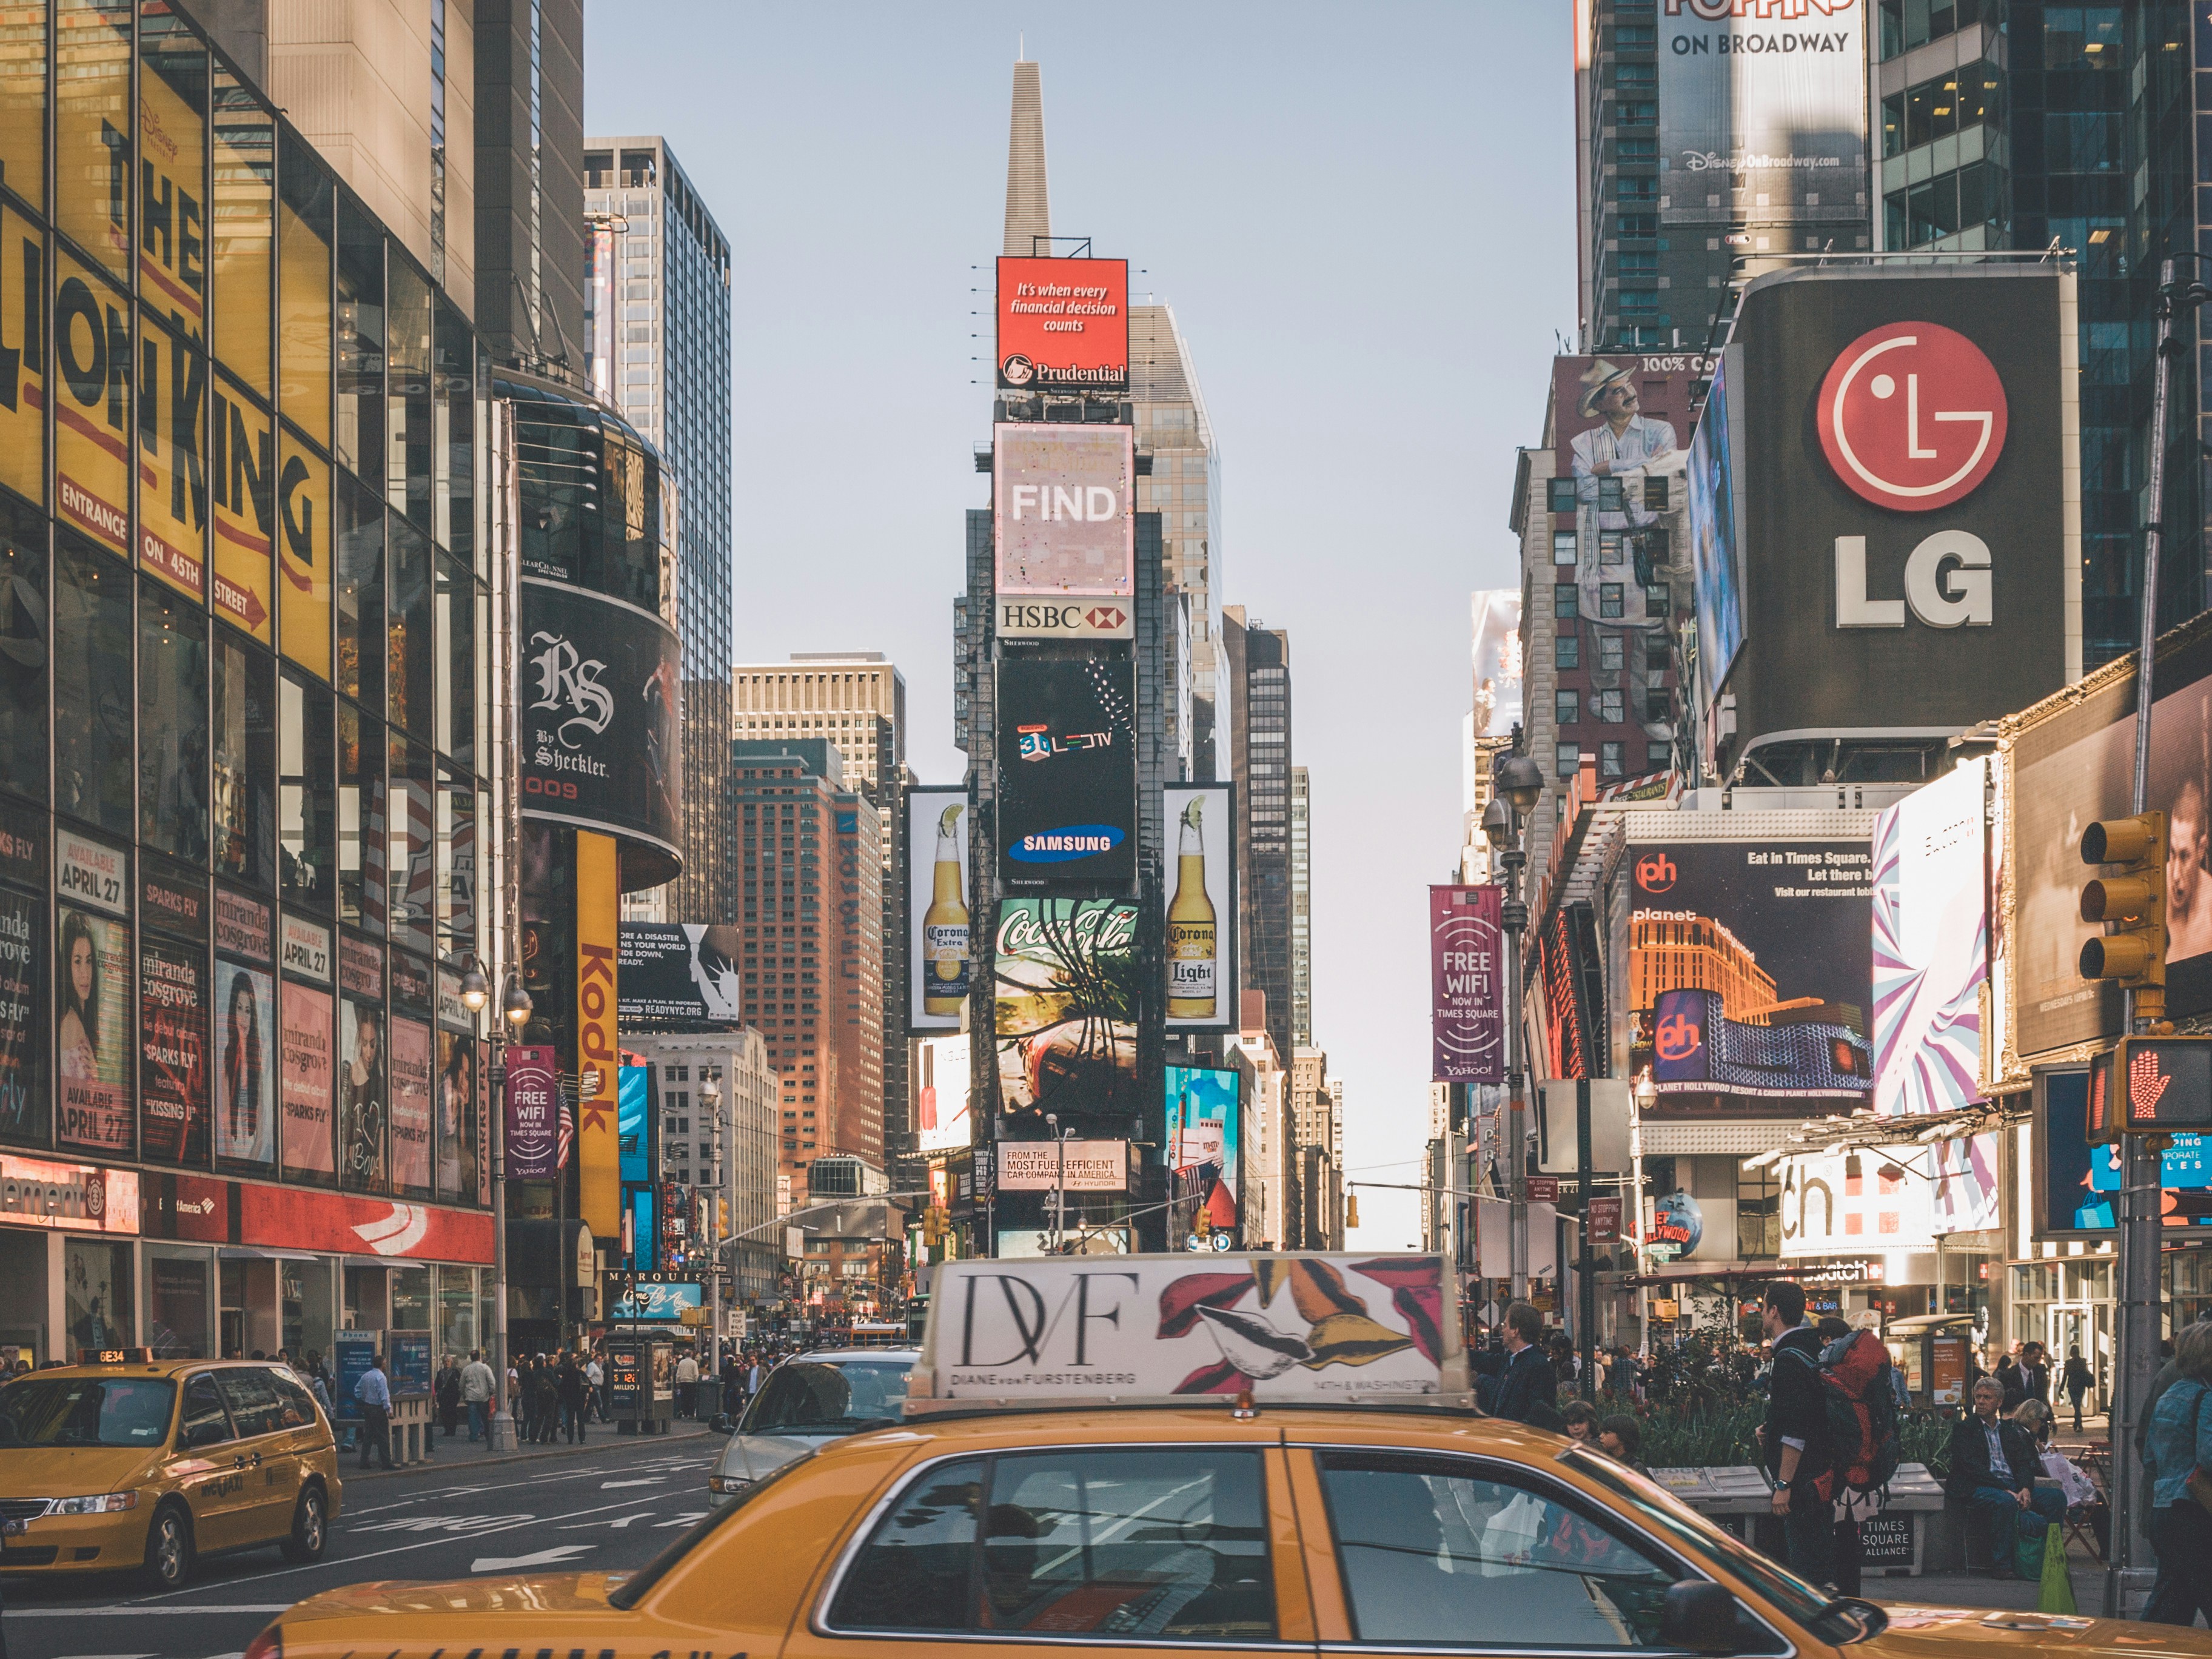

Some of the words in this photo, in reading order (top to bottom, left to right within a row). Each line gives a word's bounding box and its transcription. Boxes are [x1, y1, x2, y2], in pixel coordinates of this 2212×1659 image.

[1671, 34, 1709, 55] ON
[1718, 32, 1849, 55] BROADWAY
[102, 117, 202, 296] THE
[1017, 282, 1036, 296] It's
[1038, 283, 1071, 297] when
[1073, 287, 1107, 300] every
[1011, 300, 1065, 314] financial
[1067, 301, 1116, 315] decision
[1044, 320, 1084, 332] counts
[1036, 363, 1125, 381] Prudential
[1643, 357, 1686, 373] 100%
[172, 309, 313, 568] KING
[1012, 485, 1116, 521] FIND
[62, 481, 127, 541] ENTRANCE
[144, 535, 164, 564] ON
[170, 552, 199, 586] 45TH
[214, 578, 247, 617] STREET
[1835, 529, 1992, 629] LG
[1002, 606, 1081, 629] HSBC
[535, 729, 554, 746] By
[535, 745, 608, 778] Sheckler
[1024, 836, 1111, 851] SAMSUNG
[1748, 852, 1768, 865] Eat
[1771, 852, 1783, 864] in
[1785, 851, 1823, 864] Times
[1825, 851, 1872, 866] Square.
[1807, 868, 1828, 881] Let
[1829, 868, 1862, 880] there
[61, 863, 101, 899] APRIL
[104, 877, 121, 903] 27
[1774, 887, 1795, 897] Visit
[1811, 888, 1855, 897] restaurant
[146, 883, 183, 911] SPARKS
[183, 897, 199, 917] FLY
[1632, 907, 1697, 923] planet
[645, 933, 679, 942] DISASTER
[927, 925, 969, 942] Corona
[1170, 925, 1214, 944] Corona
[1714, 918, 1755, 962] hollywood
[658, 942, 686, 951] WORLD
[937, 938, 963, 947] Extra
[284, 941, 312, 970] APRIL
[314, 951, 326, 974] 27
[1443, 951, 1491, 971] FREE
[143, 951, 196, 985] miranda
[1172, 961, 1211, 982] Light
[1446, 974, 1488, 994] WIFI
[1452, 997, 1473, 1006] NOW
[1474, 997, 1483, 1006] IN
[2039, 995, 2074, 1013] WEDNESDAYS
[645, 1005, 702, 1016] READYNYC.ORG
[1436, 1008, 1464, 1019] TIMES
[1465, 1009, 1499, 1019] SQUARE
[581, 942, 615, 1134] Kodak
[1444, 1065, 1492, 1076] YAHOO!
[1654, 1082, 1682, 1093] PLANET
[1683, 1082, 1730, 1093] HOLLYWOOD
[1731, 1085, 1757, 1096] RESORT
[1757, 1088, 1763, 1096] &
[1763, 1088, 1785, 1097] CASINO
[514, 1091, 548, 1105] FREE
[517, 1106, 545, 1121] WIFI
[60, 1107, 101, 1141] APRIL
[105, 1115, 122, 1143] 27
[529, 1129, 552, 1138] SQUARE
[514, 1167, 546, 1176] YAHOO!
[1007, 1160, 1035, 1170] MOST
[1038, 1160, 1114, 1170] FUEL-EFFICIENT
[180, 1199, 201, 1214] America
[1597, 1204, 1619, 1213] STOPPING
[1595, 1216, 1613, 1226] ANYTIME
[609, 1272, 702, 1282] MARQUIS
[1823, 1302, 1838, 1310] BAR
[951, 1272, 1139, 1367] DVF
[99, 1350, 125, 1362] 6E34
[613, 1373, 619, 1382] $
[950, 1374, 997, 1385] DIANE
[1023, 1373, 1136, 1385] FURSTENBERG
[1866, 1520, 1905, 1532] TIMES
[1862, 1533, 1909, 1546] SQUARE
[1865, 1547, 1907, 1556] ALLIANCE
